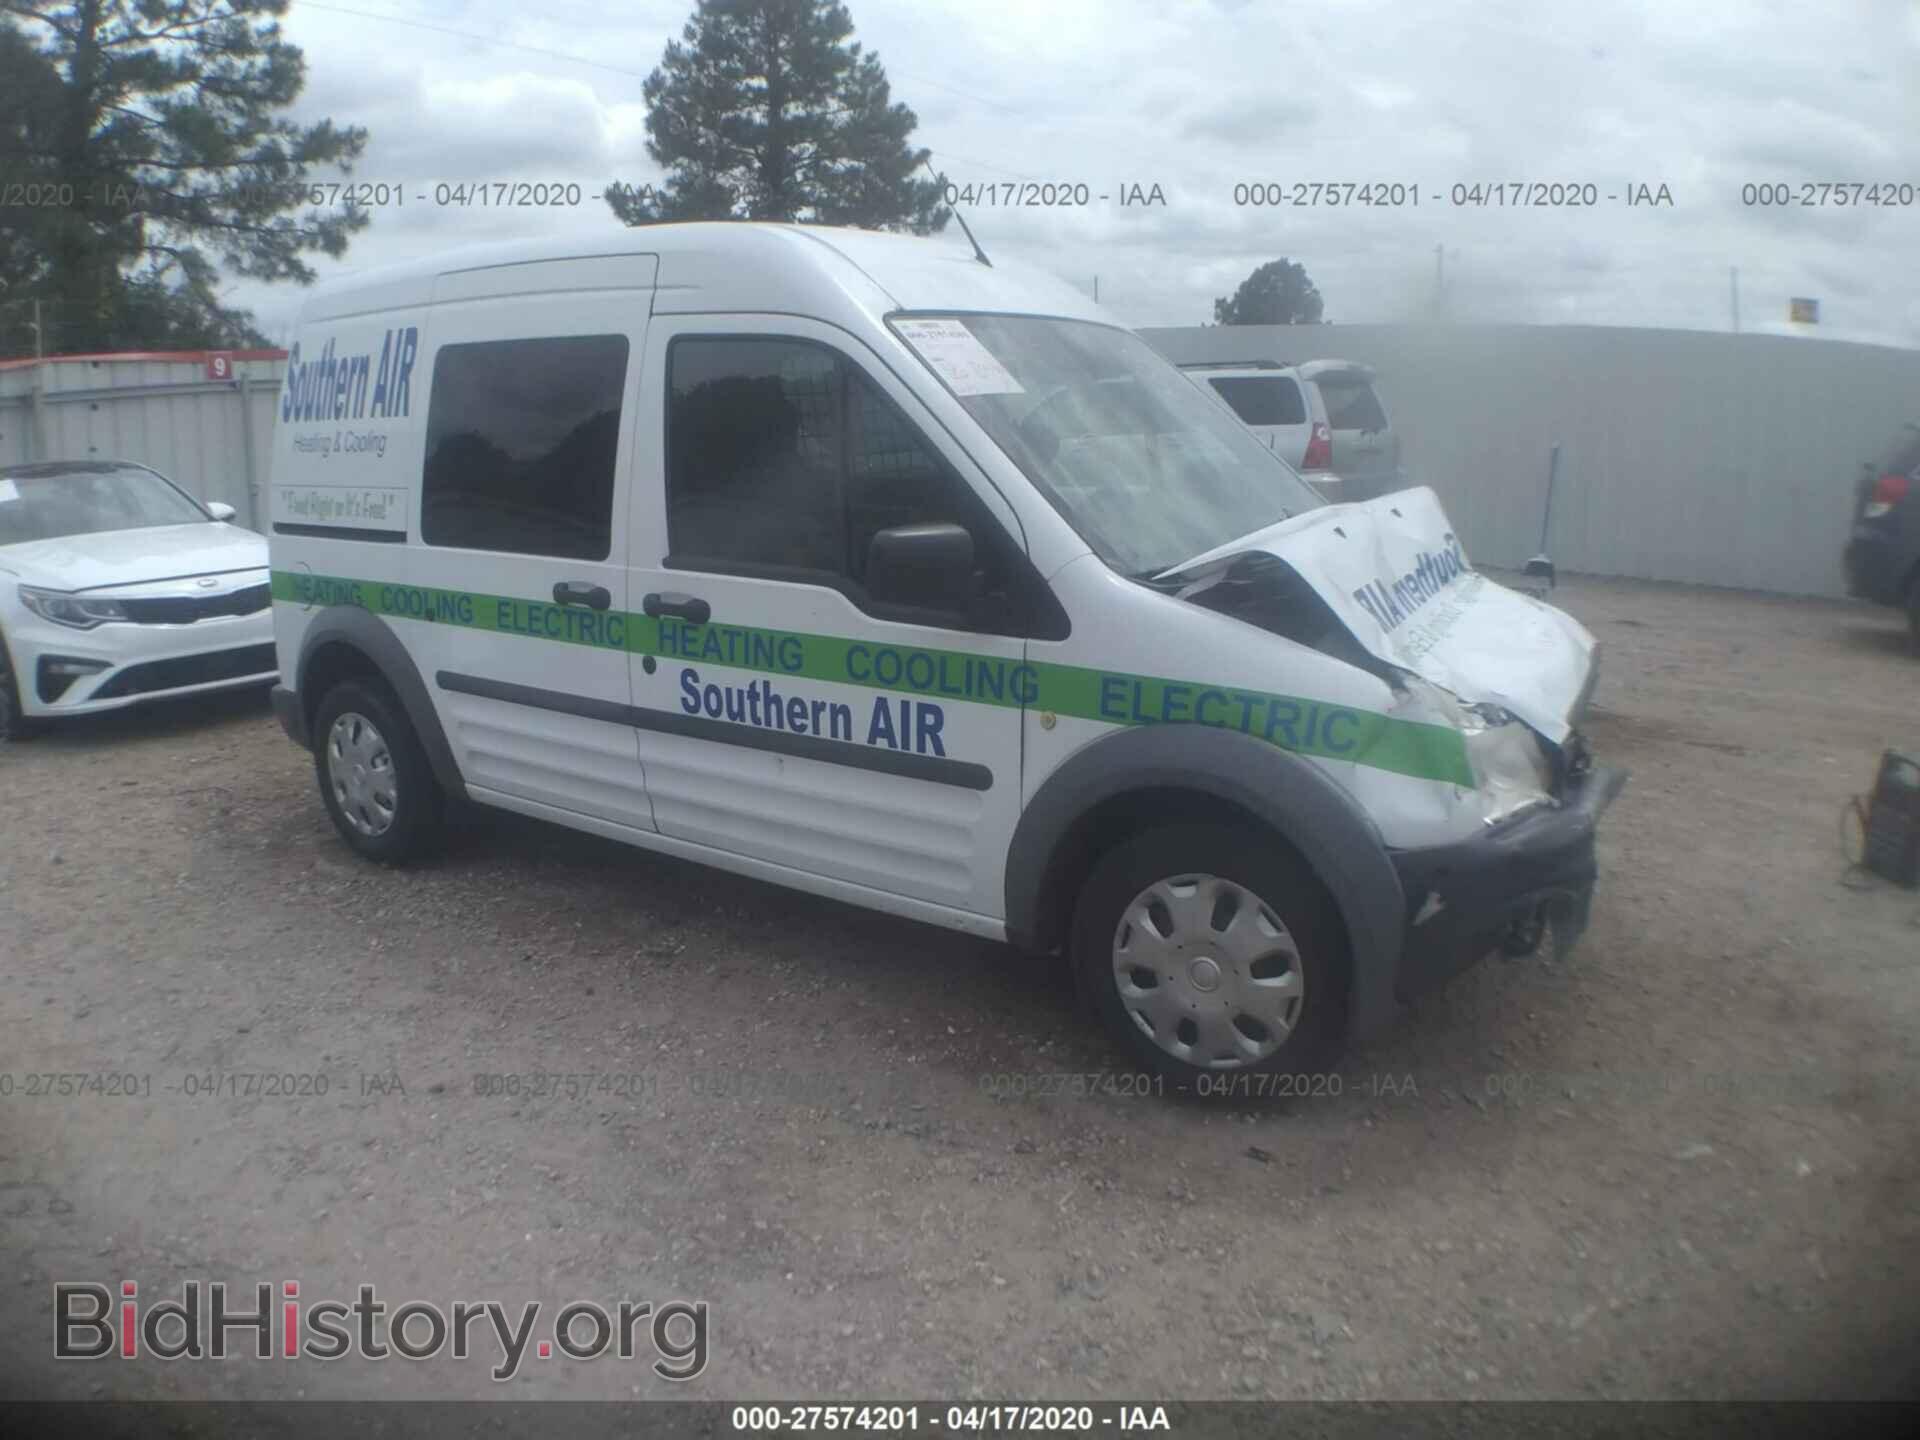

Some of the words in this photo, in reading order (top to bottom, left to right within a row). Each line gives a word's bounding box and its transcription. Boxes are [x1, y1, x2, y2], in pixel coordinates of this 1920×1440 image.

[213, 357, 226, 377] 9
[282, 336, 370, 424] Southern
[370, 327, 418, 419] AIR
[380, 586, 473, 624] COOLING
[496, 599, 624, 647] ELECTRIC
[658, 618, 803, 672] HEATING
[846, 645, 1040, 704] COOLING
[1100, 677, 1360, 752] ELECTRIC
[680, 668, 852, 742] Southern
[866, 696, 946, 757] AIR
